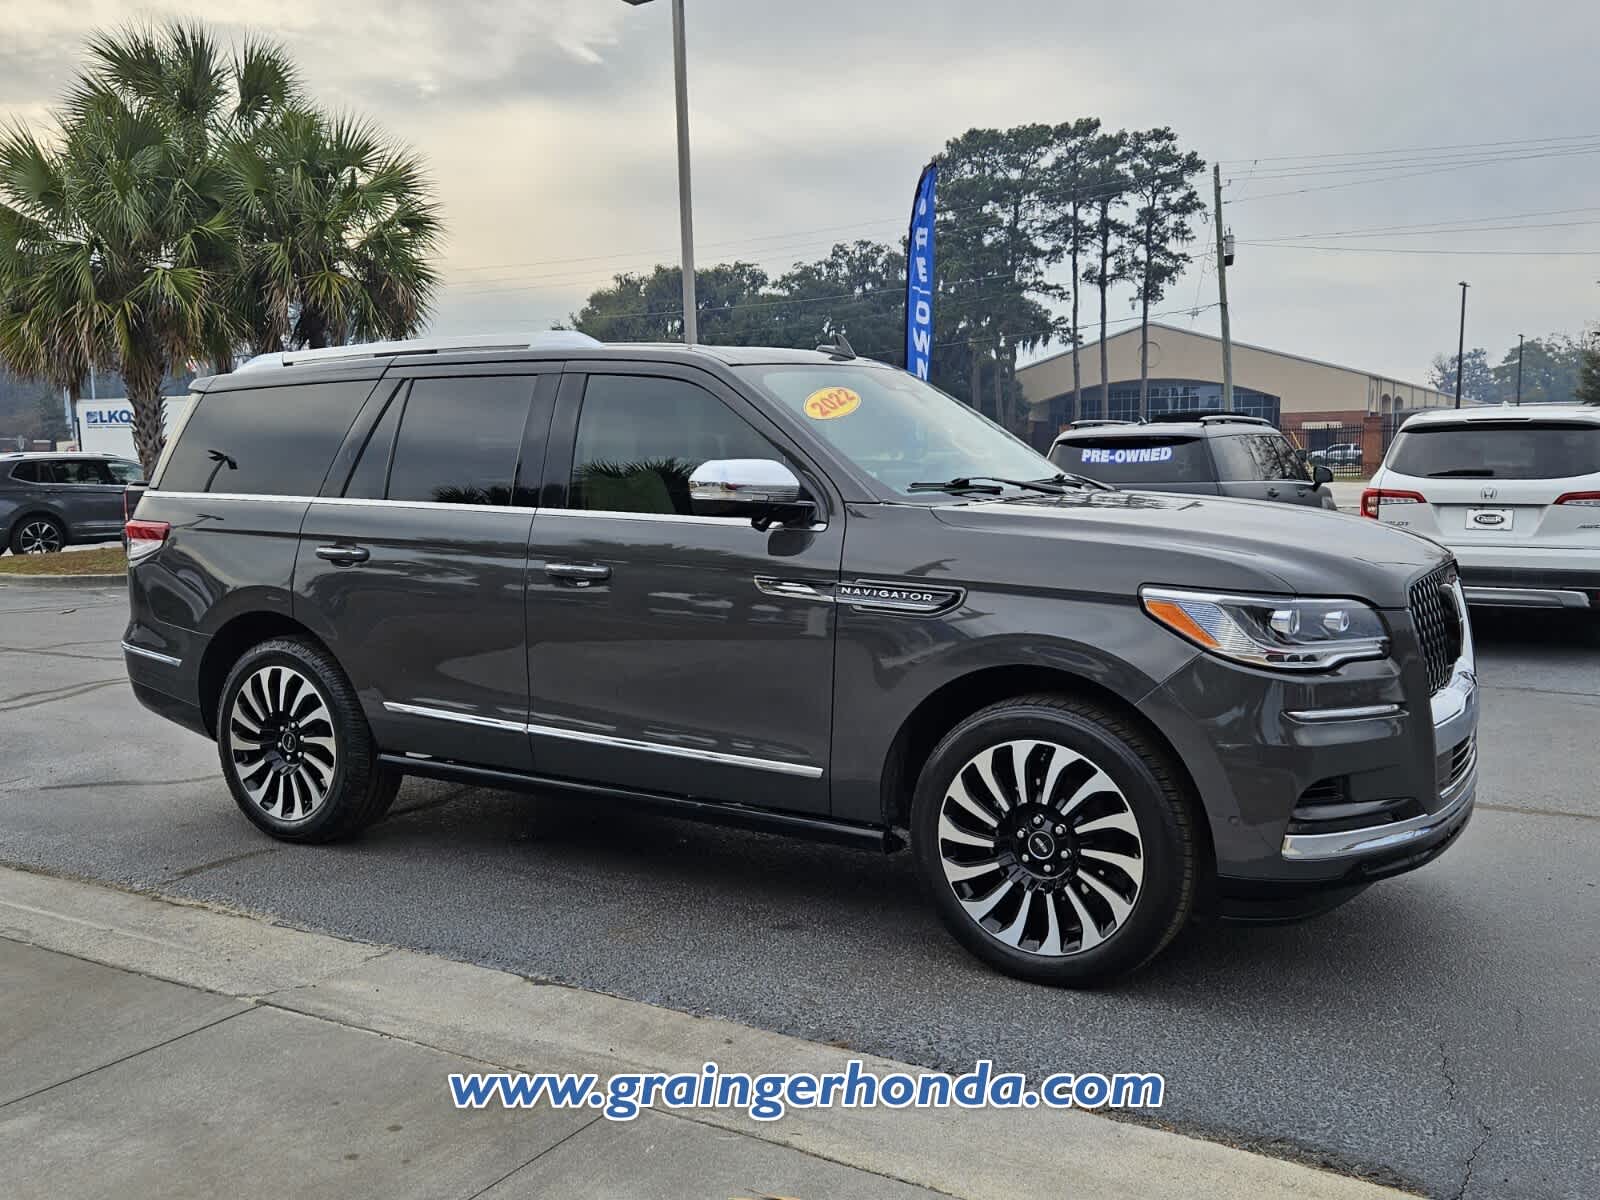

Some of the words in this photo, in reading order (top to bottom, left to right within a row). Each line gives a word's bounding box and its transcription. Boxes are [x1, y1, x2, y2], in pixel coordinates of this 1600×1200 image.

[810, 389, 856, 416] 2022
[1081, 447, 1172, 463] PRE-OWNED
[841, 586, 933, 601] NAVIGATOR
